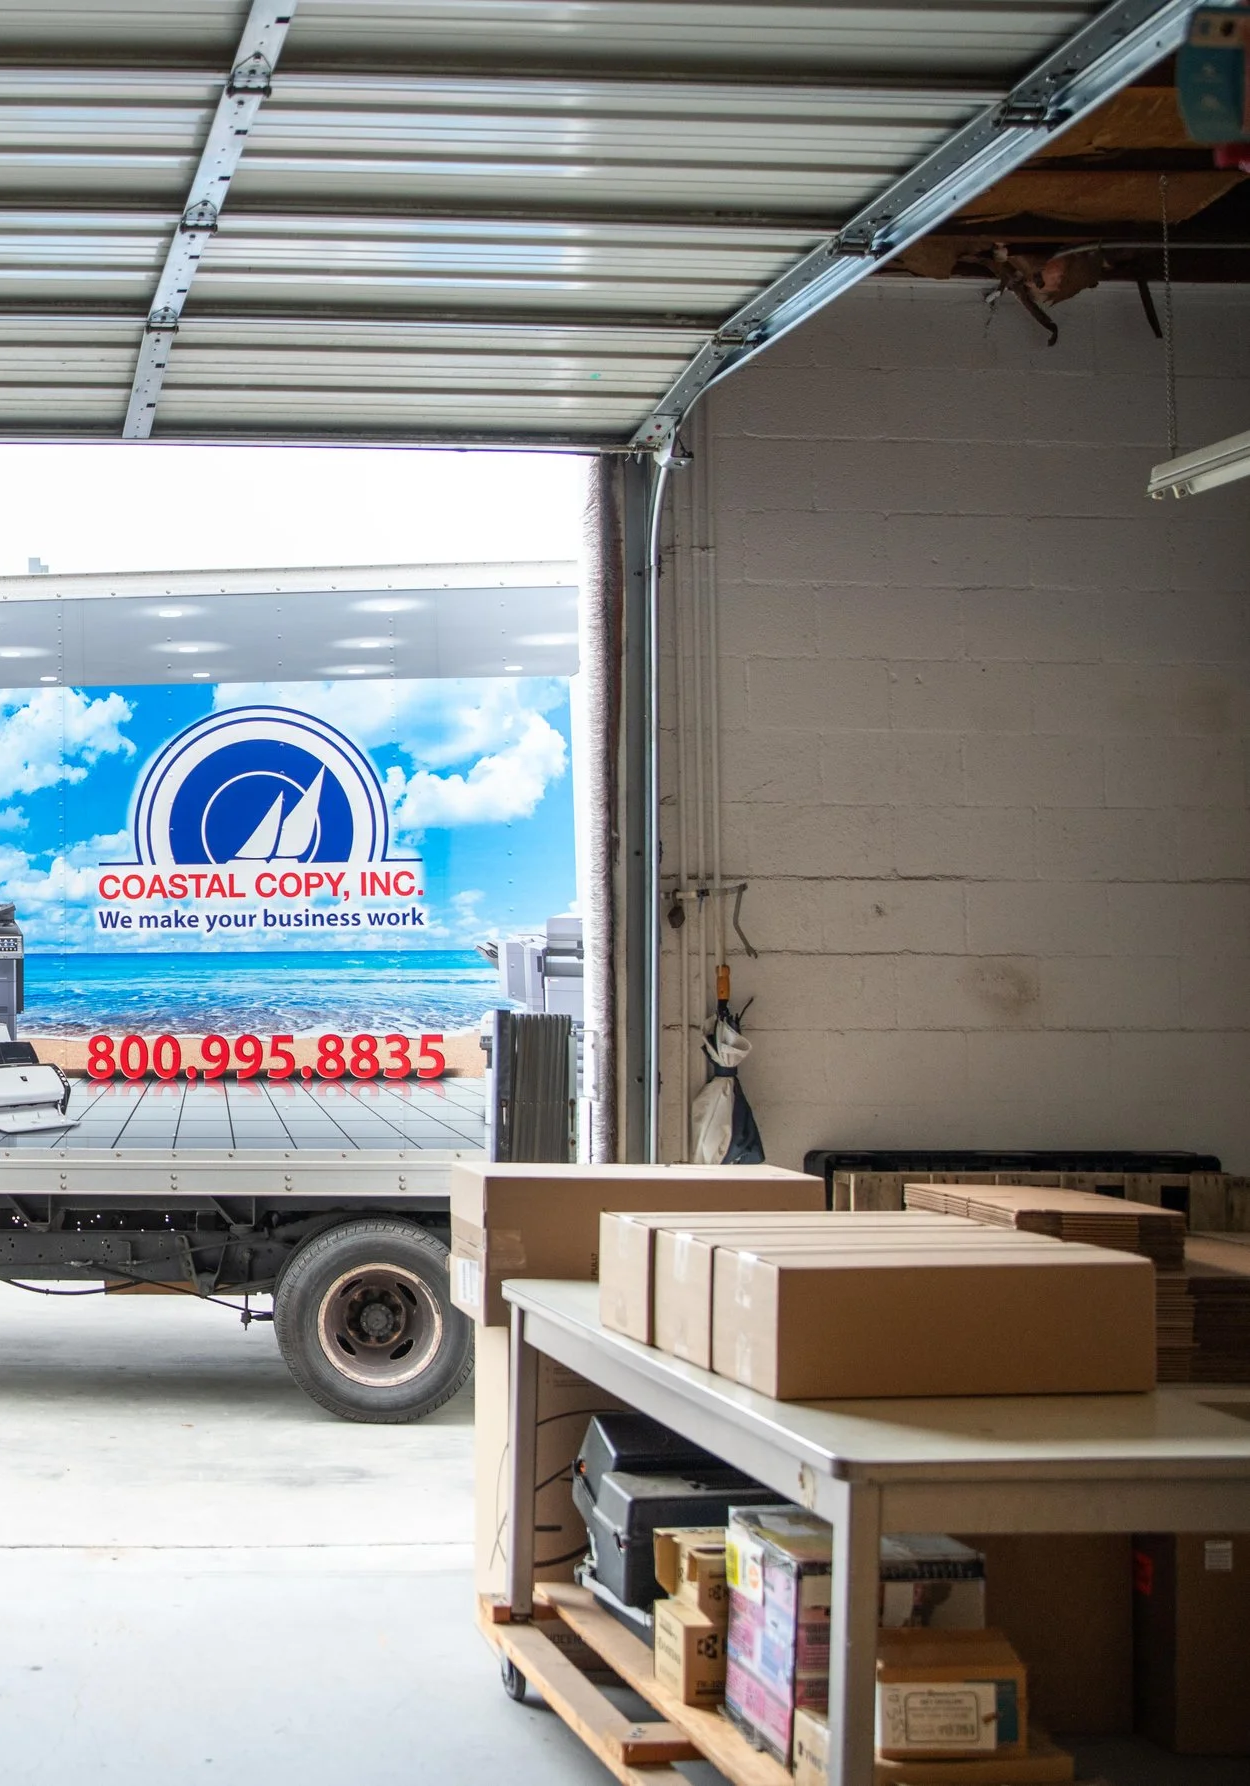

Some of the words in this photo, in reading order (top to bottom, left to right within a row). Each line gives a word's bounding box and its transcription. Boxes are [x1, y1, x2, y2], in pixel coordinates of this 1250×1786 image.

[98, 873, 246, 899] COASTAL
[255, 871, 350, 902] COPY,
[360, 870, 424, 896] INC.
[99, 911, 132, 929] We
[139, 909, 199, 928] make
[206, 913, 257, 933] your
[263, 908, 361, 928] business
[367, 907, 424, 926] work
[87, 1034, 446, 1080] 800.995.8835
